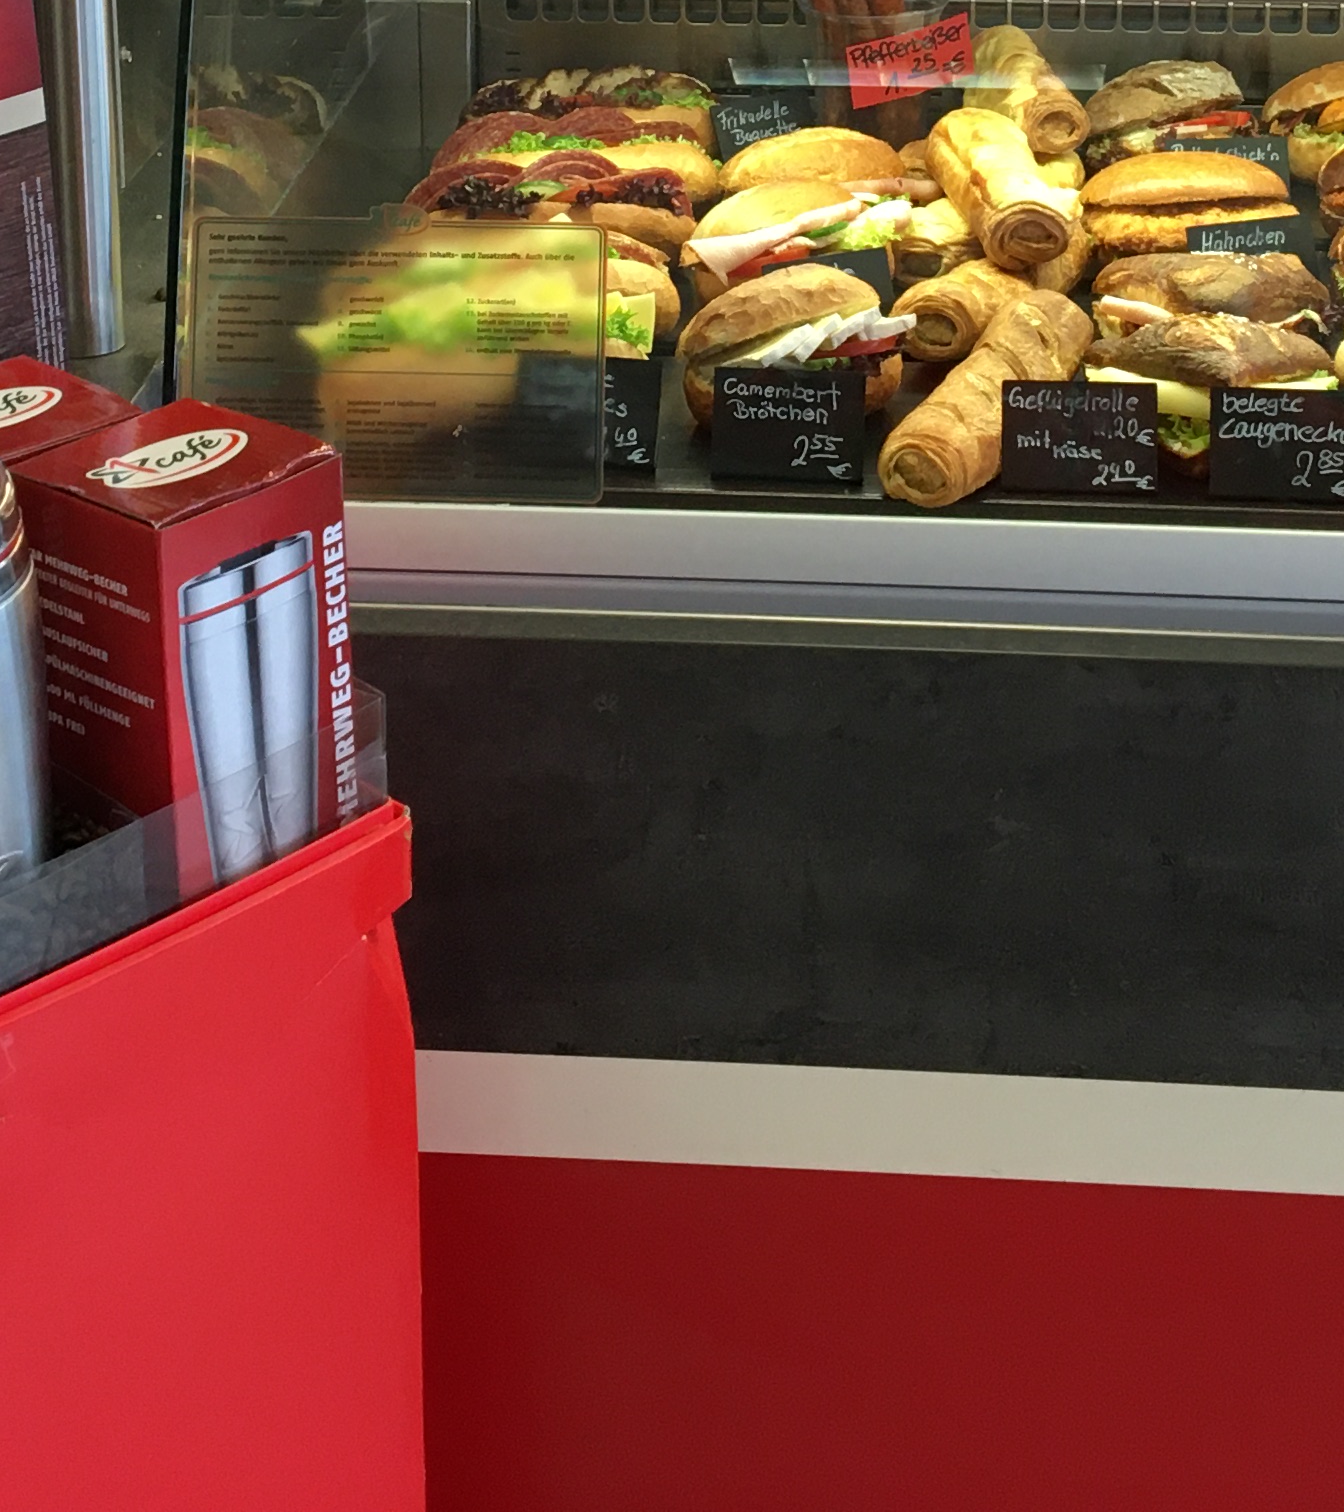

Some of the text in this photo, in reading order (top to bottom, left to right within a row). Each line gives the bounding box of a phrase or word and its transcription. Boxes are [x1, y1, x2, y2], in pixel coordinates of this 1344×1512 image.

[717, 100, 789, 131] Frikadelle
[722, 376, 841, 411] Camembert
[1008, 386, 1139, 417] Geflügelrolle
[1222, 393, 1304, 415] belegte
[732, 402, 829, 425] Brötchen
[155, 434, 223, 468] café
[1016, 430, 1051, 450] mit
